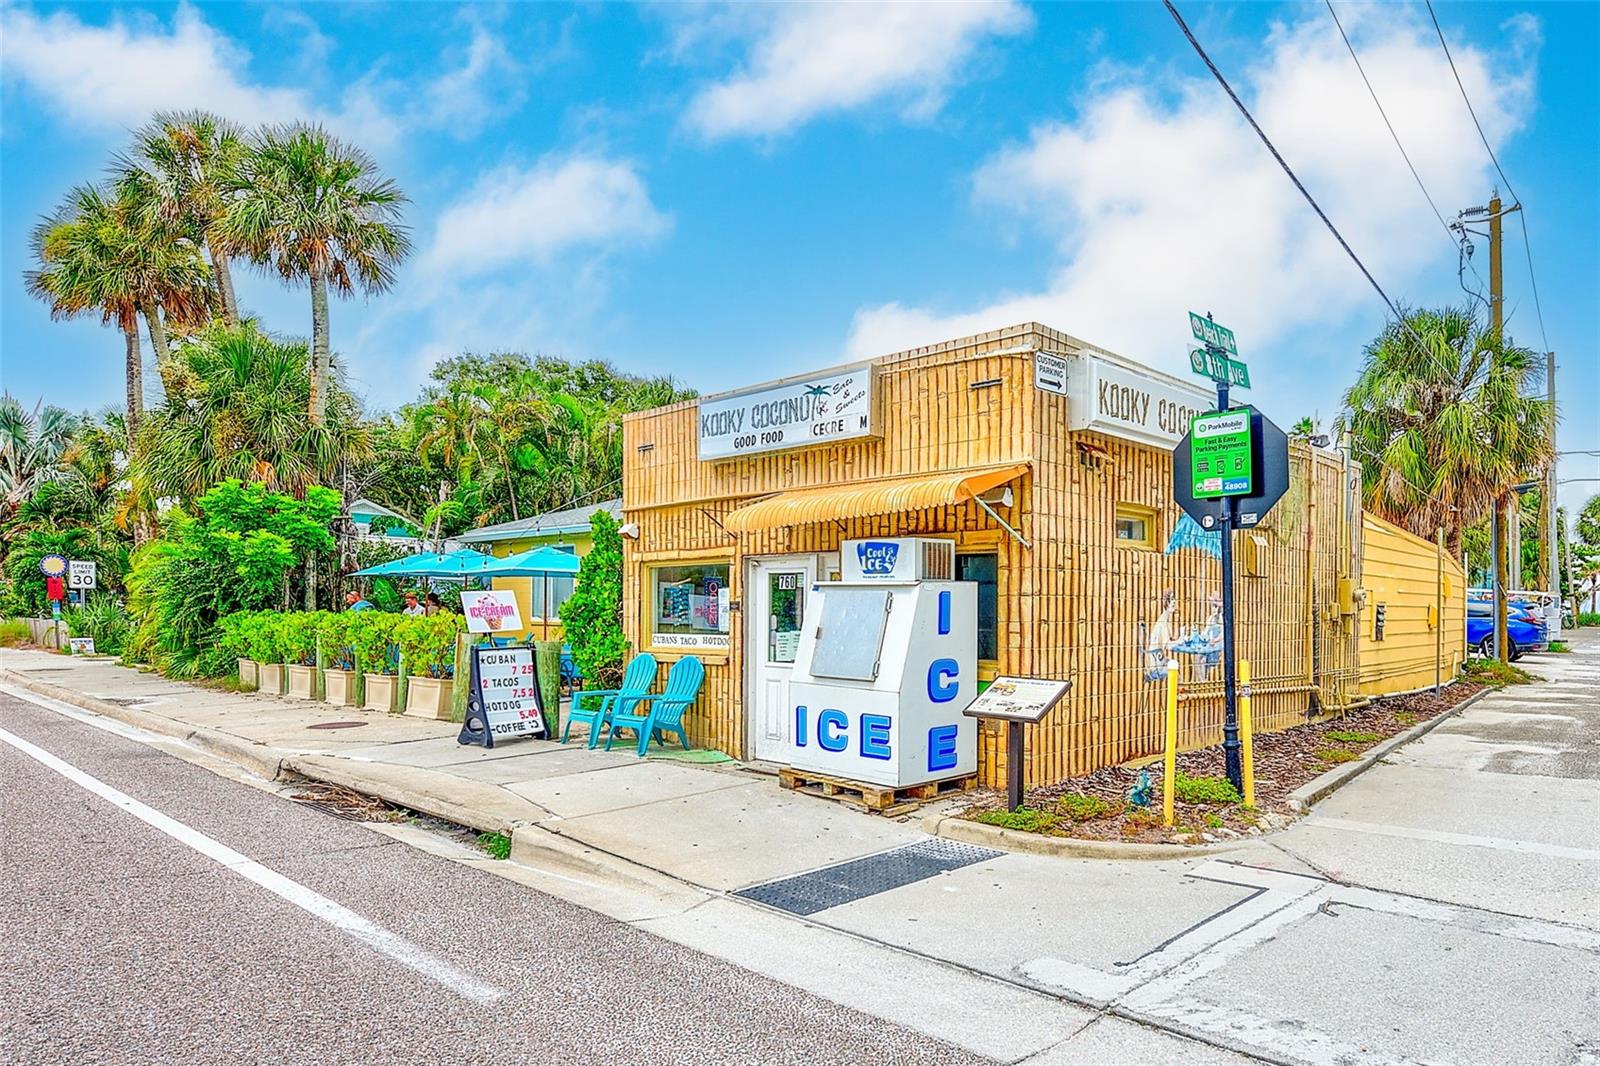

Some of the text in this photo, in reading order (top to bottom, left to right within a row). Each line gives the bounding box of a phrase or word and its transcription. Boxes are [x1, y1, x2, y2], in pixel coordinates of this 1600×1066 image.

[1037, 354, 1066, 370] CUSTOMER
[1205, 353, 1245, 384] 8th Ave
[1039, 364, 1064, 379] PARKING
[832, 378, 853, 395] Eats
[843, 389, 850, 399] &
[835, 390, 866, 414] Sweets
[1098, 378, 1150, 426] KOOKY
[701, 392, 818, 438] KOOKY COCONUT
[1208, 420, 1243, 430] ParkMobile
[734, 430, 784, 449] GOOD FOOD
[1195, 441, 1247, 453] Parking Payments
[1224, 481, 1248, 491] 48908
[867, 546, 886, 558] Cool
[860, 555, 883, 571] ICE
[72, 575, 93, 585] 30
[779, 575, 795, 589] 760
[652, 635, 678, 645] CUBANS
[680, 637, 698, 646] TACO
[482, 677, 519, 689] 2 TACOS
[927, 590, 959, 772] ICE
[486, 700, 522, 712] HOTDOG
[519, 709, 538, 720] 5.49
[795, 705, 892, 761] ICE
